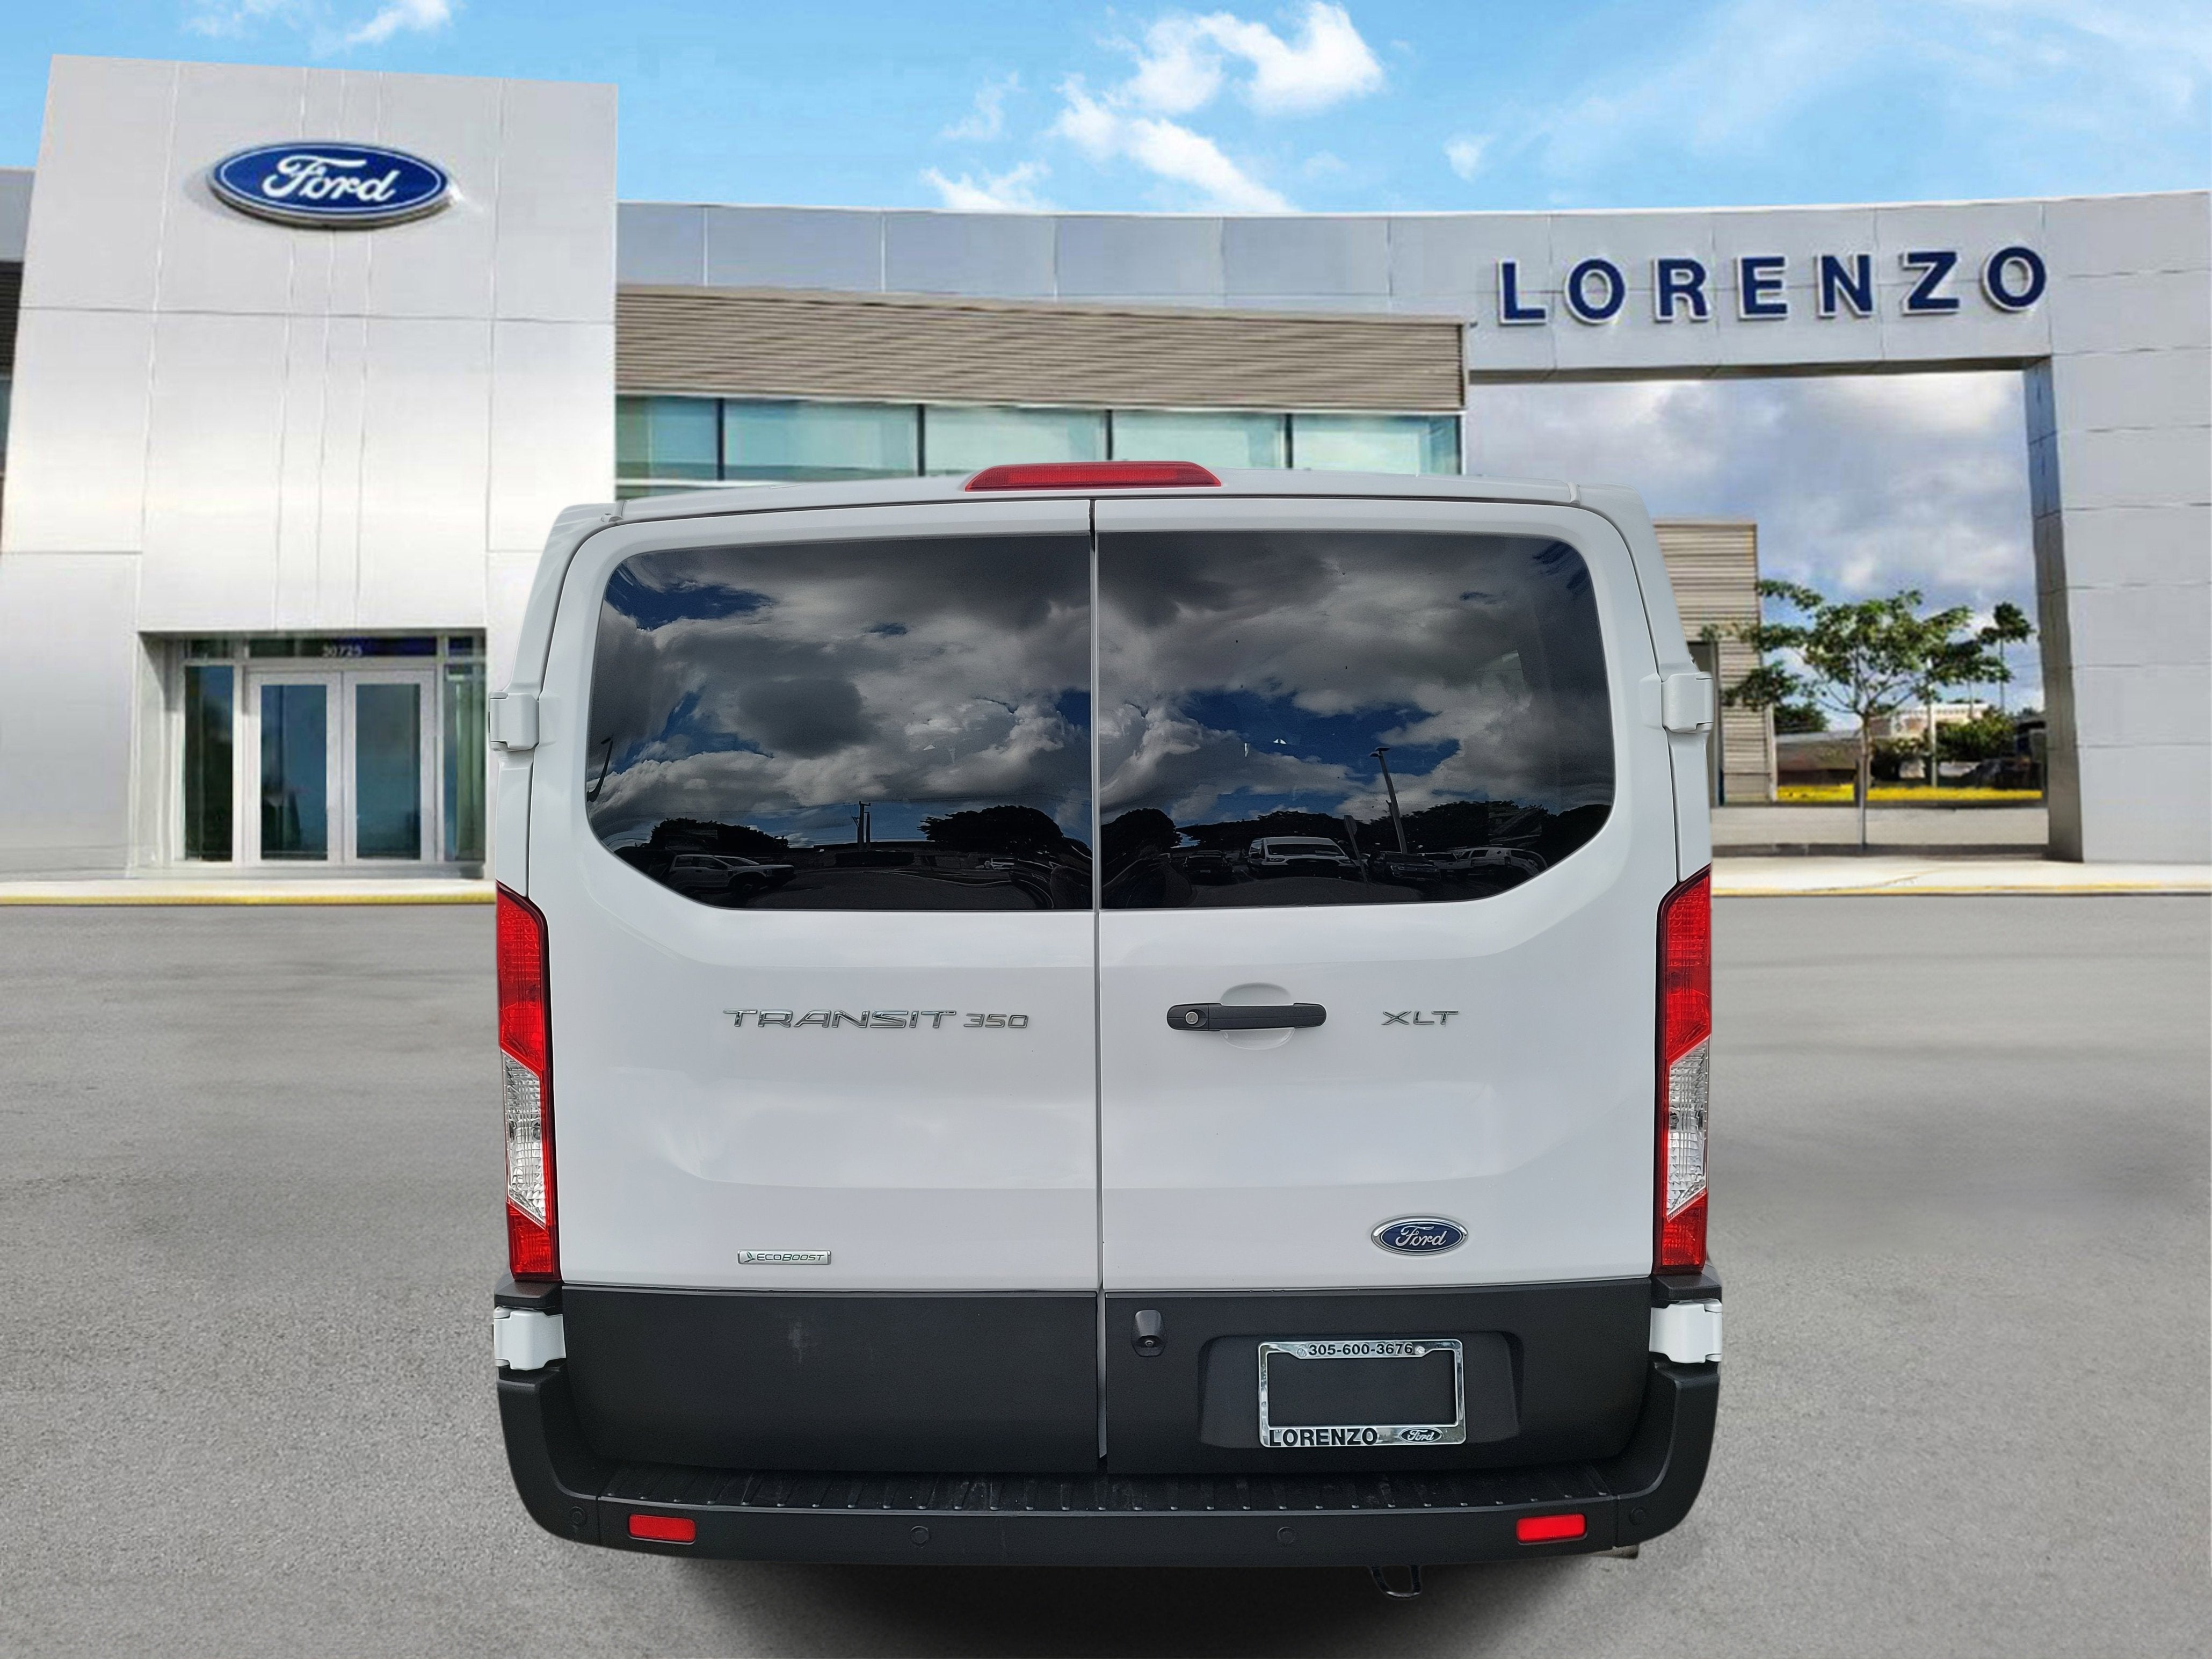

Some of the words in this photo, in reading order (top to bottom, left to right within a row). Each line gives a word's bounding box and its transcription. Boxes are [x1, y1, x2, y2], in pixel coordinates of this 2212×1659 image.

[262, 154, 400, 201] Ford
[1498, 245, 2048, 324] LORENZO
[723, 1009, 957, 1028] TRANSIT
[963, 1013, 1029, 1028] 350
[1381, 1011, 1460, 1025] XLT
[1395, 1226, 1447, 1246] Ford
[1308, 1343, 1413, 1356] 305-600-3676
[1270, 1428, 1378, 1447] LORENZO
[1407, 1429, 1434, 1441] Ford
